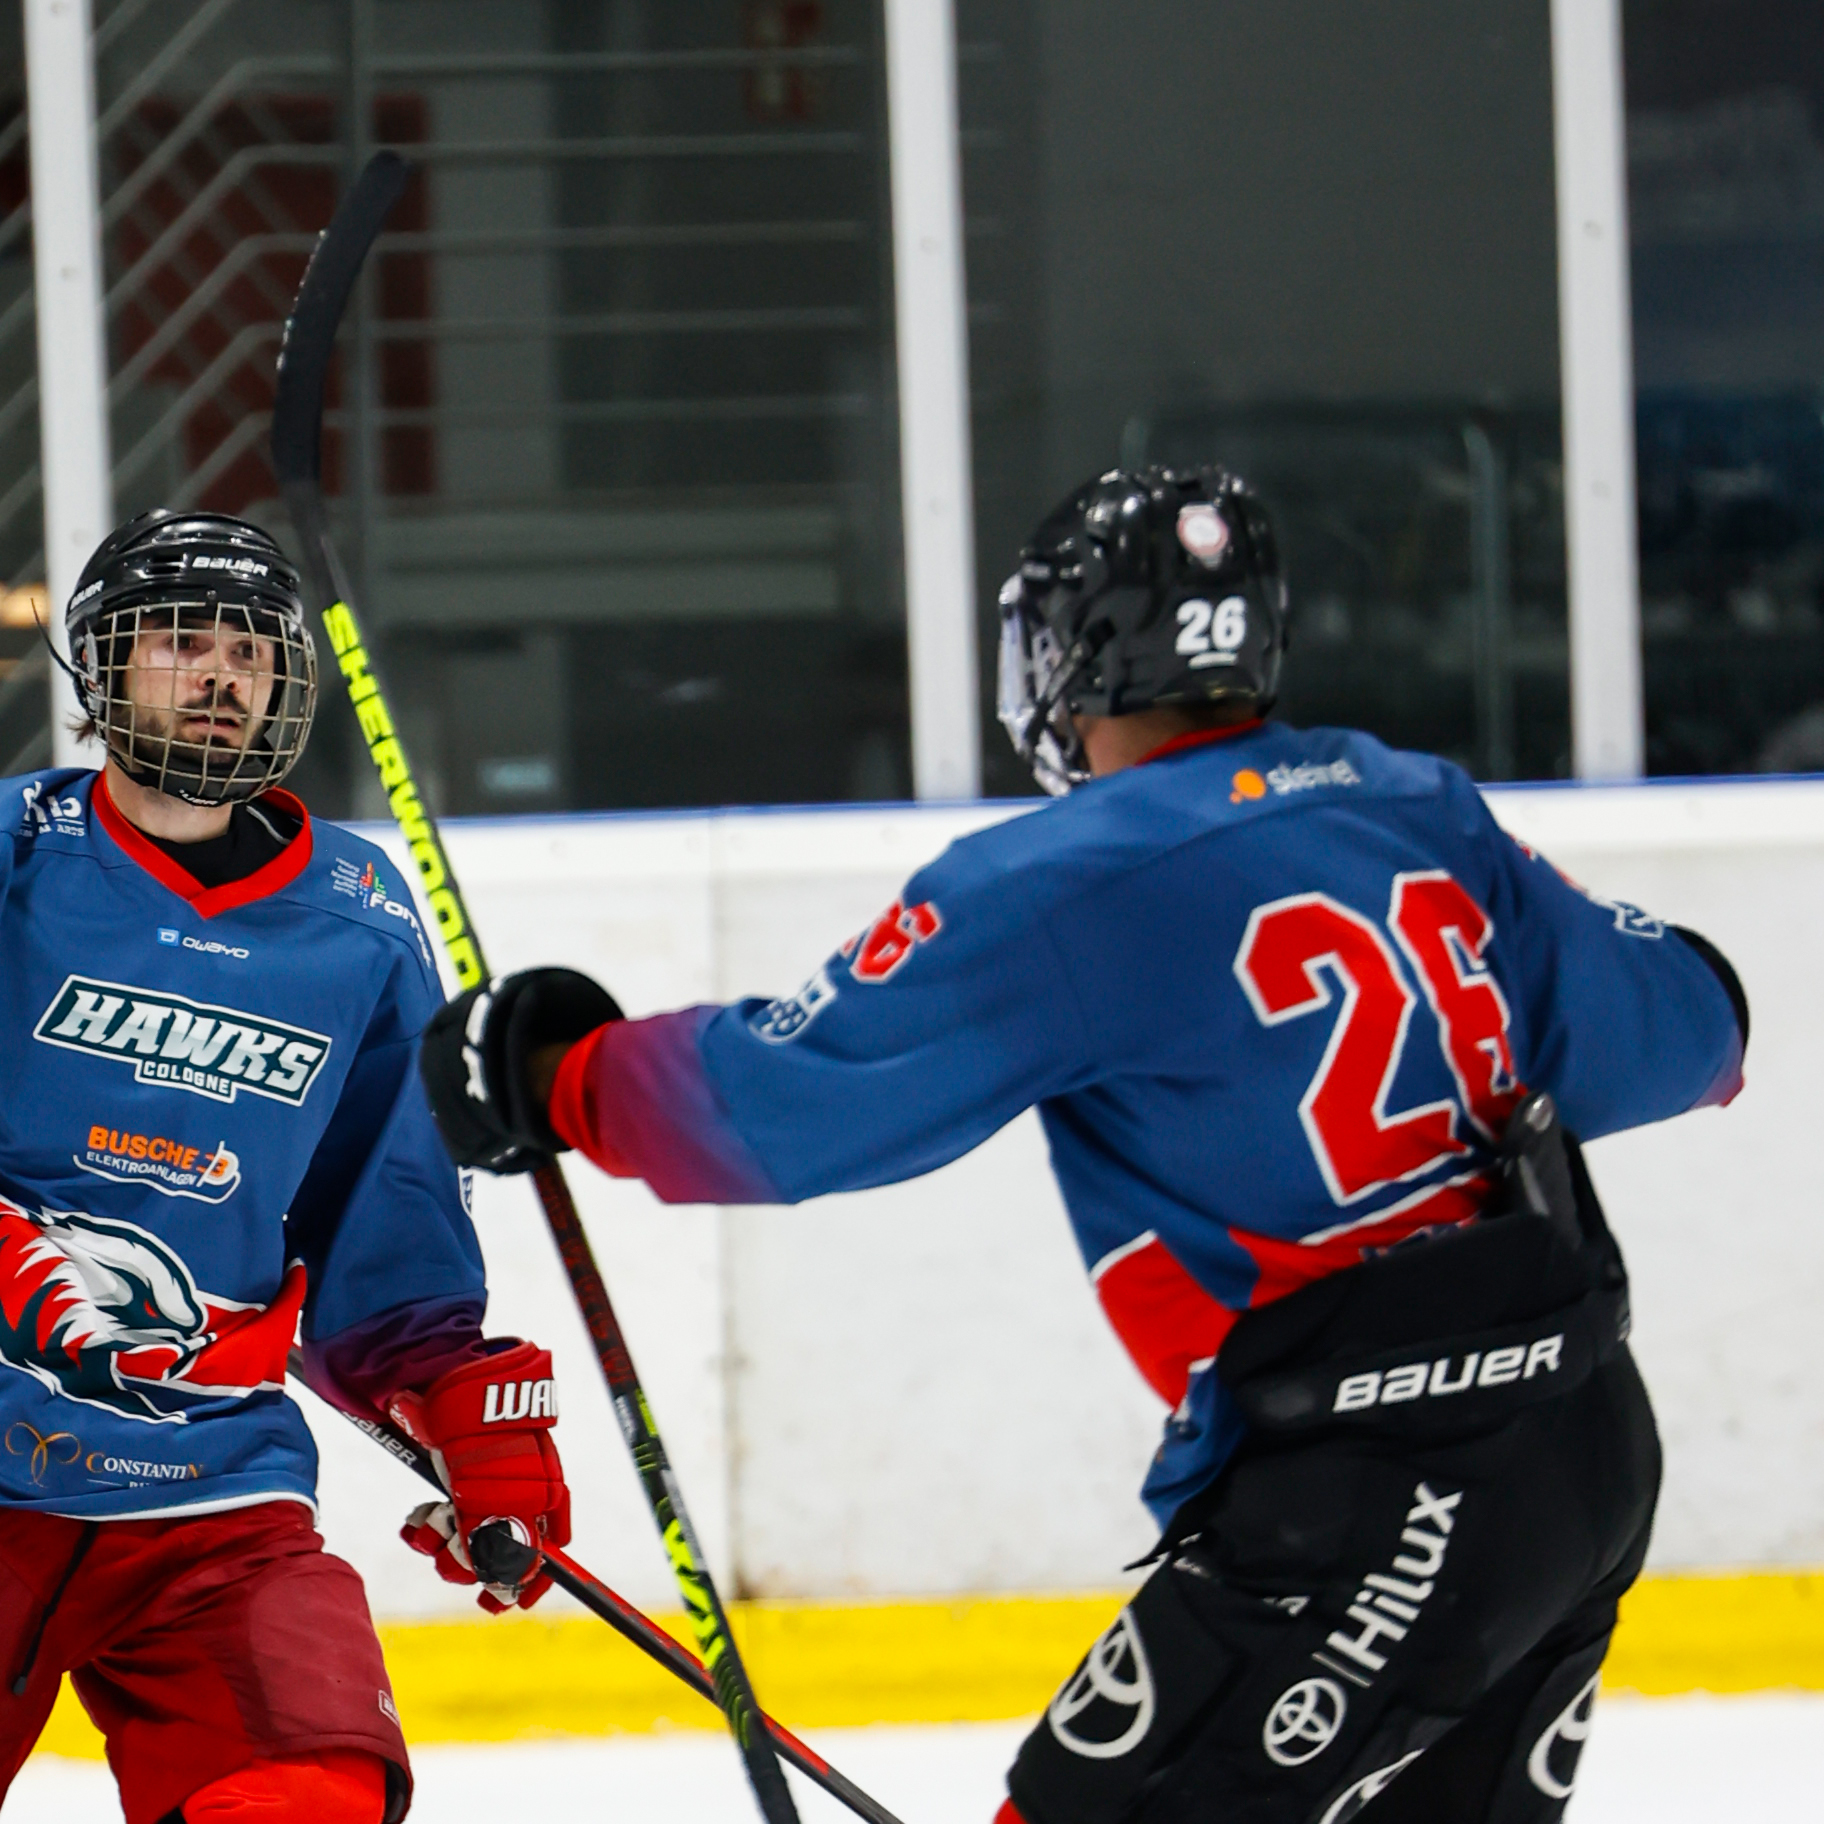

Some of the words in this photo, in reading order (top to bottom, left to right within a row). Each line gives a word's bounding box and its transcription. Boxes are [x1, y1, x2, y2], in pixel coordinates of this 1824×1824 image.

[192, 555, 269, 577] BAUER
[1174, 595, 1247, 656] 26
[321, 600, 483, 993] SHERWOOD
[839, 898, 943, 985] 6
[50, 989, 323, 1093] HAWKS
[143, 1060, 231, 1095] COLOGNE
[1233, 868, 1516, 1209] 26
[87, 1124, 200, 1170] BUSCHE
[1333, 1334, 1564, 1414] BAUER
[87, 1452, 205, 1480] CONSTANTIN
[1325, 1481, 1463, 1672] Hilux
